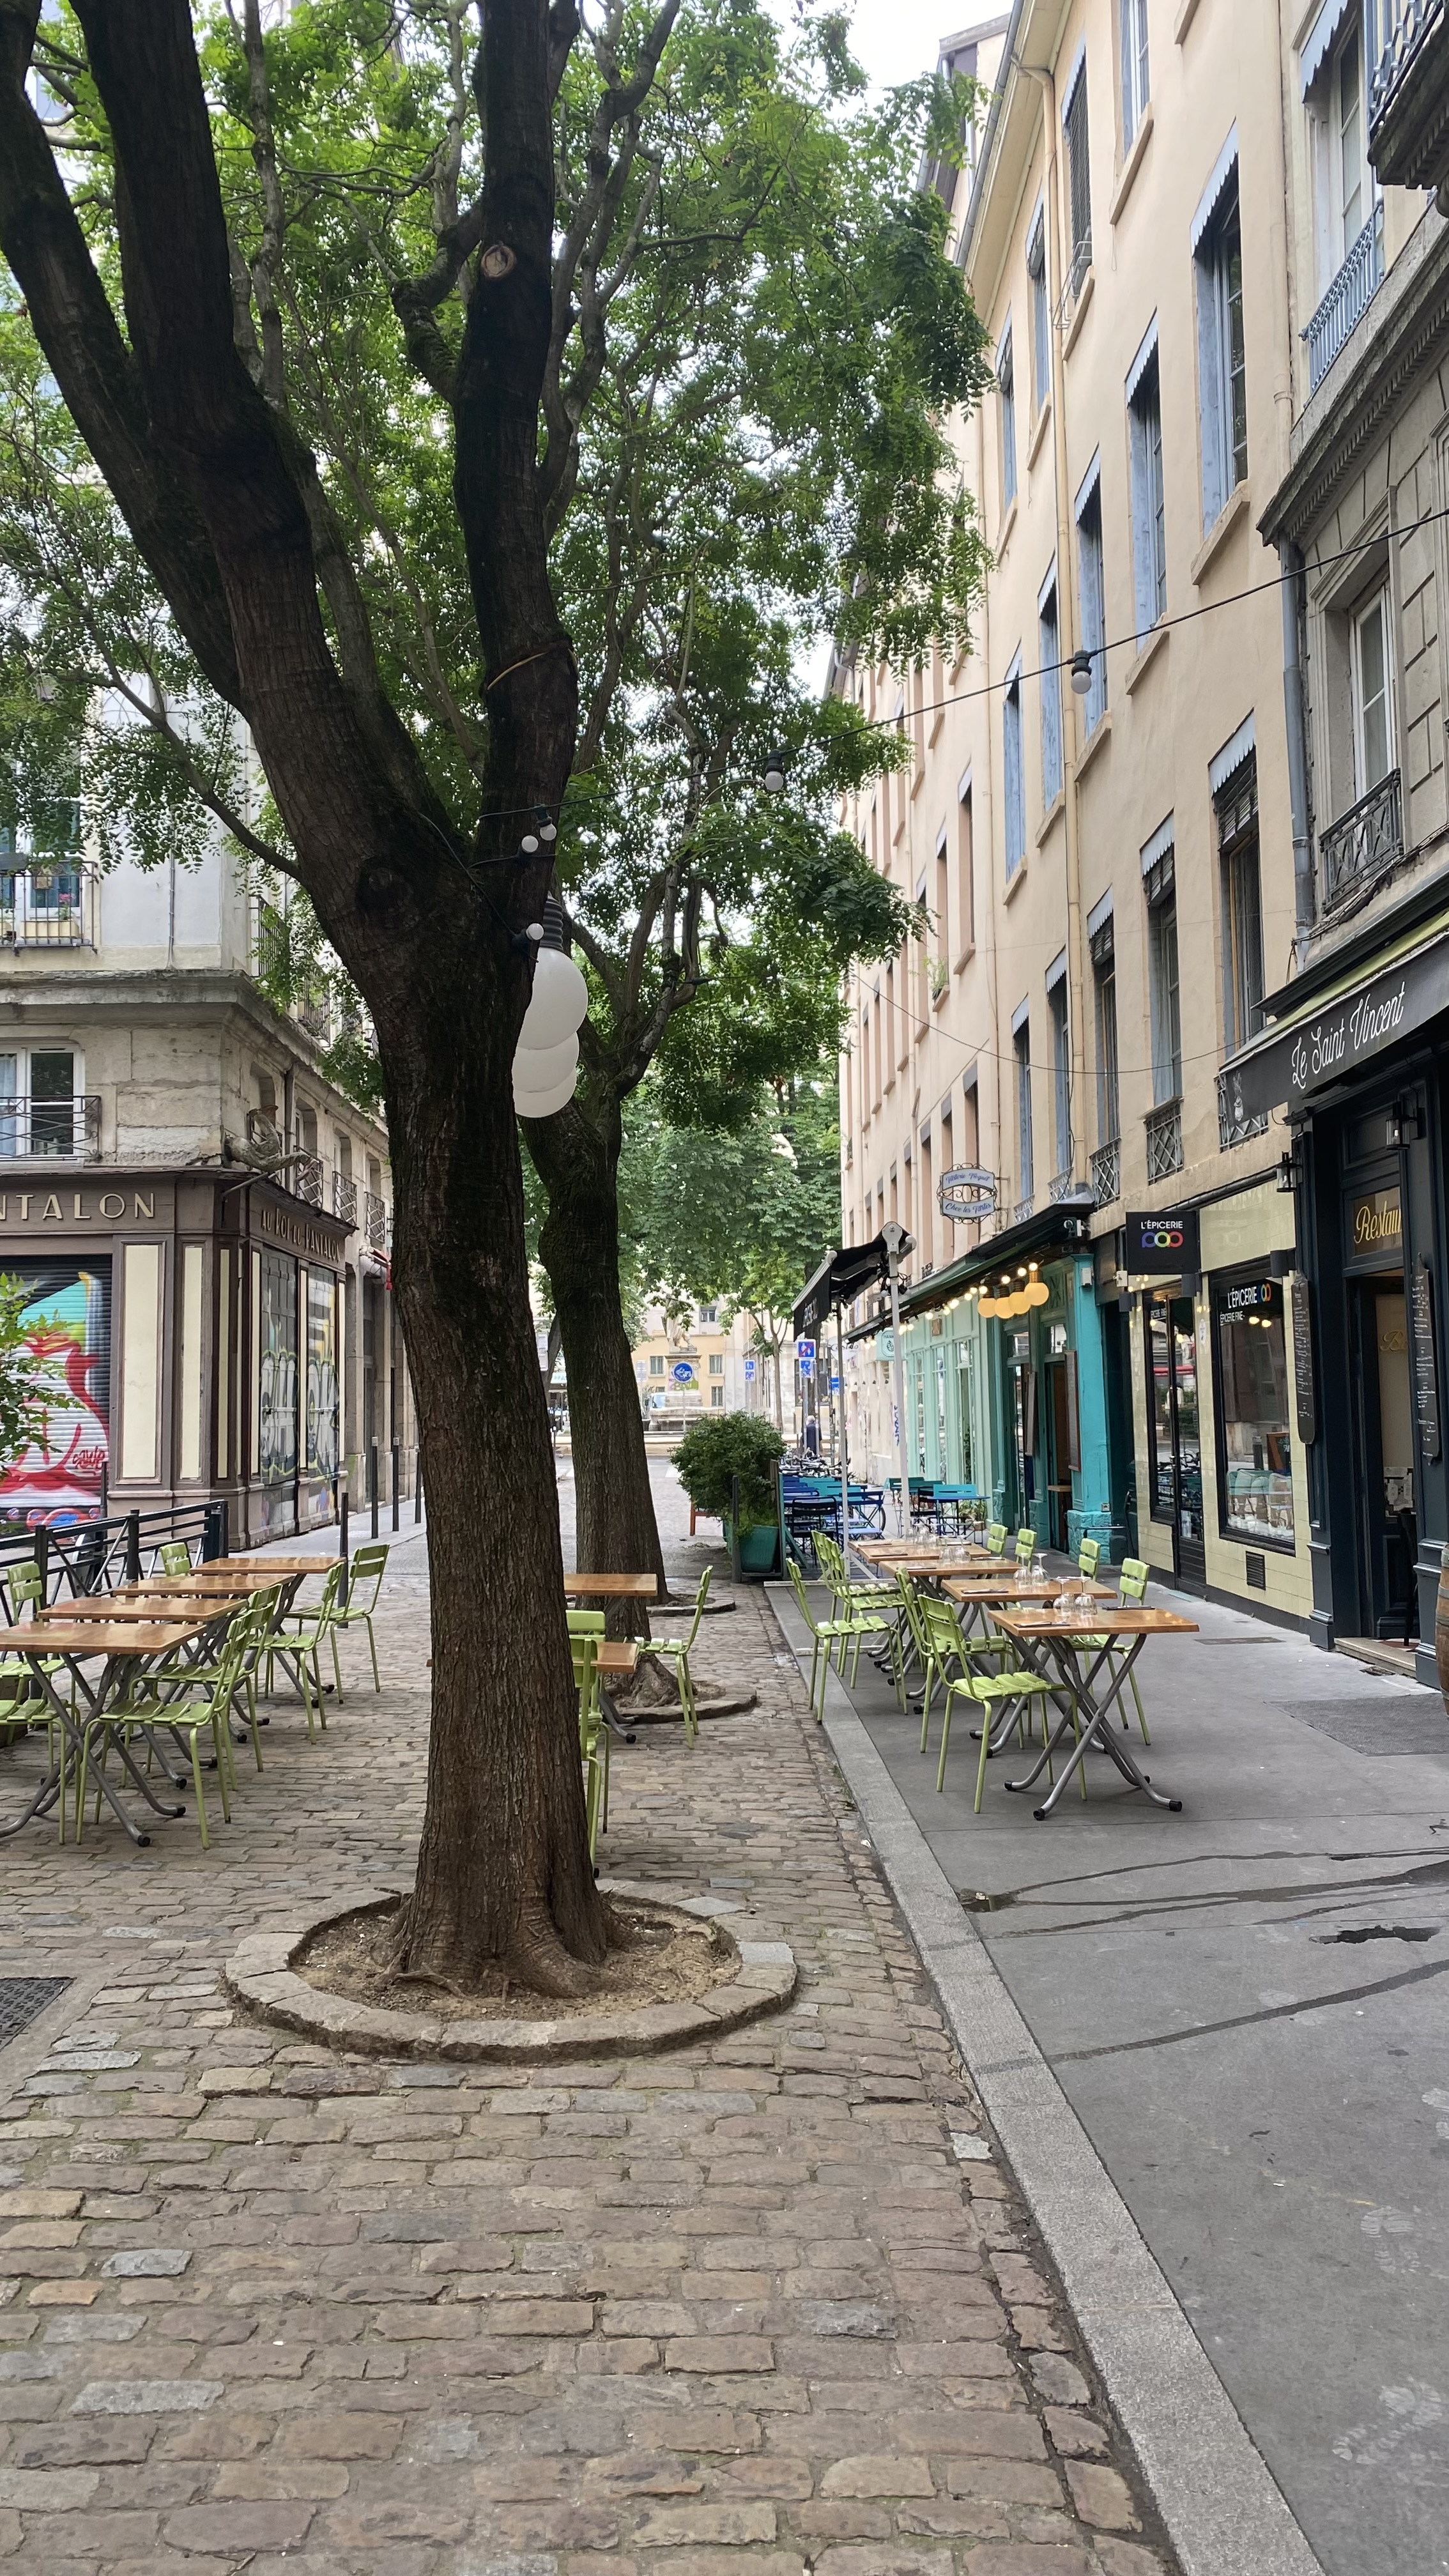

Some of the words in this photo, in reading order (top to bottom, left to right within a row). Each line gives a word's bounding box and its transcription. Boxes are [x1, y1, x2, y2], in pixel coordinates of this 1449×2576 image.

[1291, 1036, 1308, 1089] Le
[1310, 1018, 1345, 1075] Saint
[1349, 981, 1406, 1050] Vincent
[945, 1202, 962, 1212] Chez
[261, 1209, 272, 1232] AU
[275, 1208, 290, 1240] ROI
[293, 1225, 302, 1245] DU
[304, 1223, 341, 1263] PANTALON
